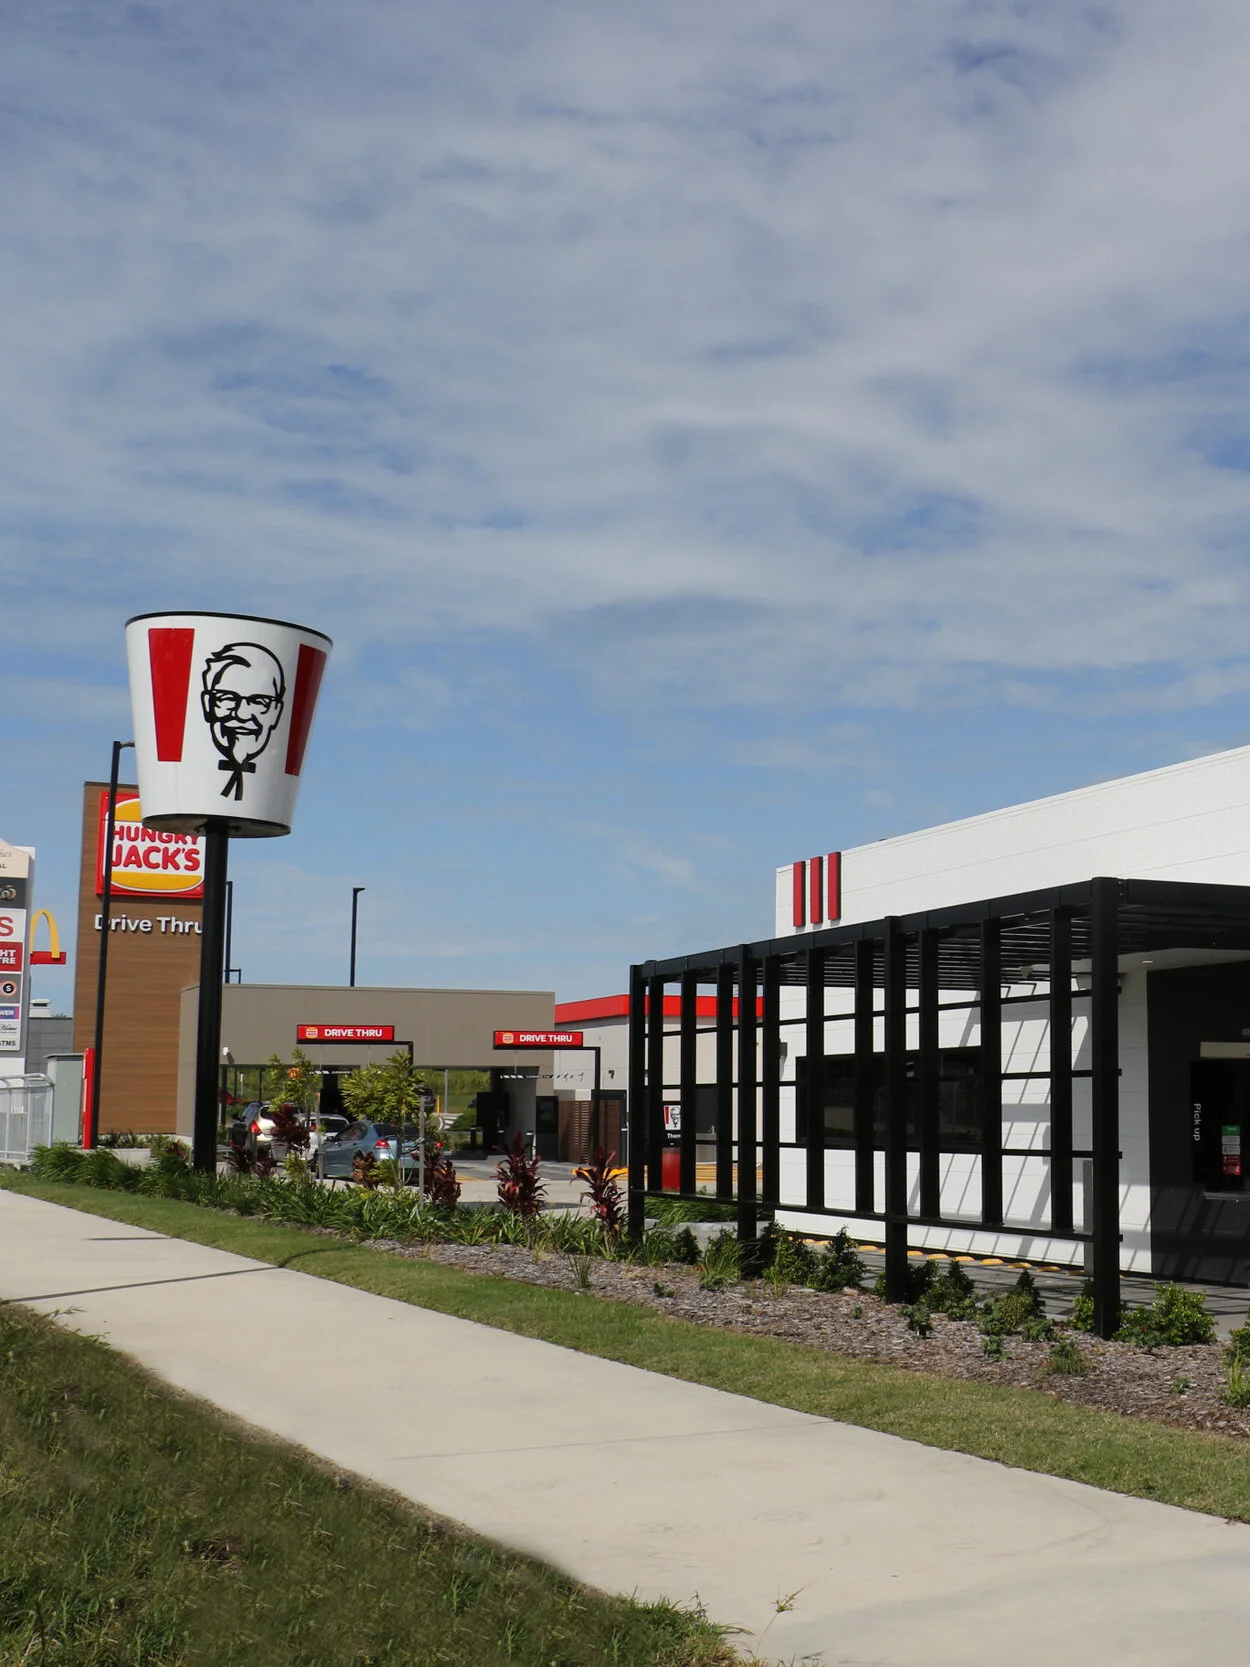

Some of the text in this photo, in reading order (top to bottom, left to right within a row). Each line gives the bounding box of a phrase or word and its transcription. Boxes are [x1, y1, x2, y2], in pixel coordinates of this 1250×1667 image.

[113, 825, 200, 845] HUNGRY
[111, 844, 200, 871] JACK'S
[156, 916, 203, 935] Thru
[324, 1029, 354, 1037] DRIVE
[355, 1029, 383, 1037] THRU
[519, 1034, 547, 1042] DRIVE
[547, 1034, 573, 1042] THRU
[1192, 1103, 1202, 1141] Pick up
